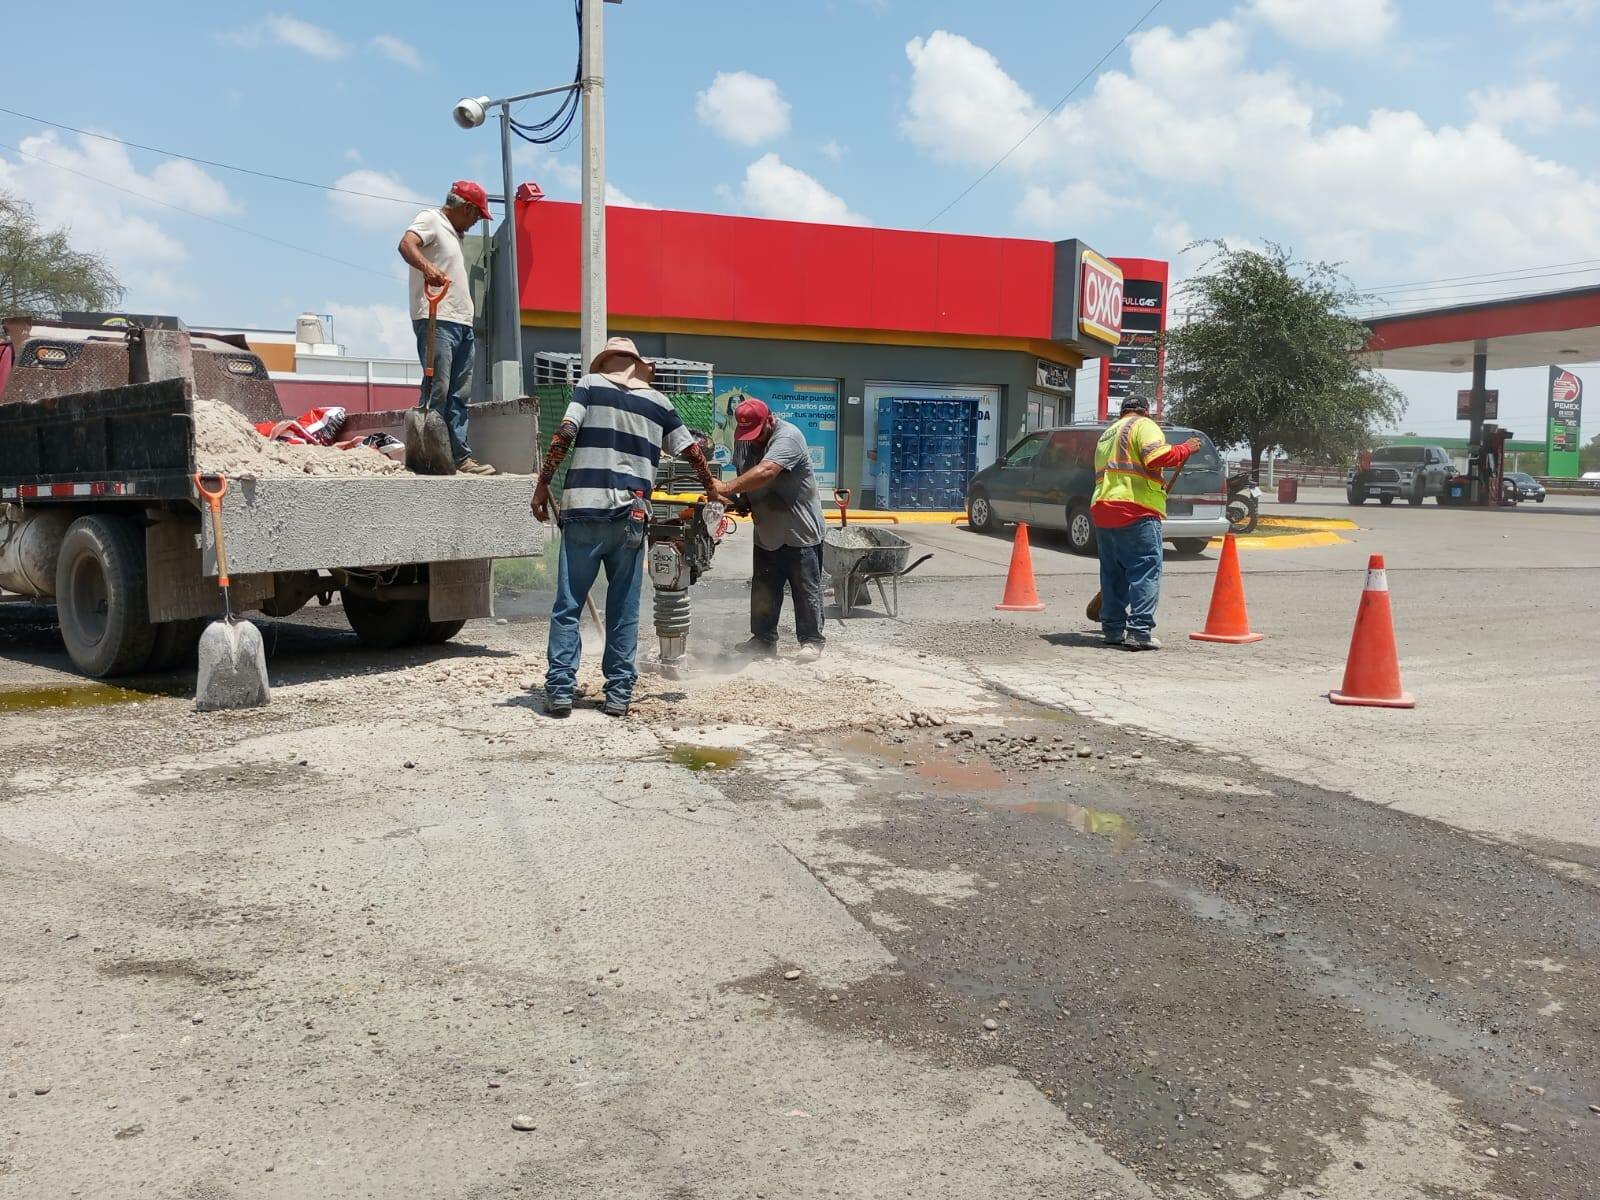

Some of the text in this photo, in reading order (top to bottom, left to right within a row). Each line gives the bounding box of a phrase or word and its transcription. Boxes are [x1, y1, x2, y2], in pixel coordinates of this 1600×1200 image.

[1086, 271, 1121, 327] OXXO
[771, 393, 836, 402] Acumular puntos
[791, 402, 818, 410] usarlos
[818, 403, 836, 411] para
[1554, 402, 1580, 410] PEMEX
[809, 411, 836, 420] antojos
